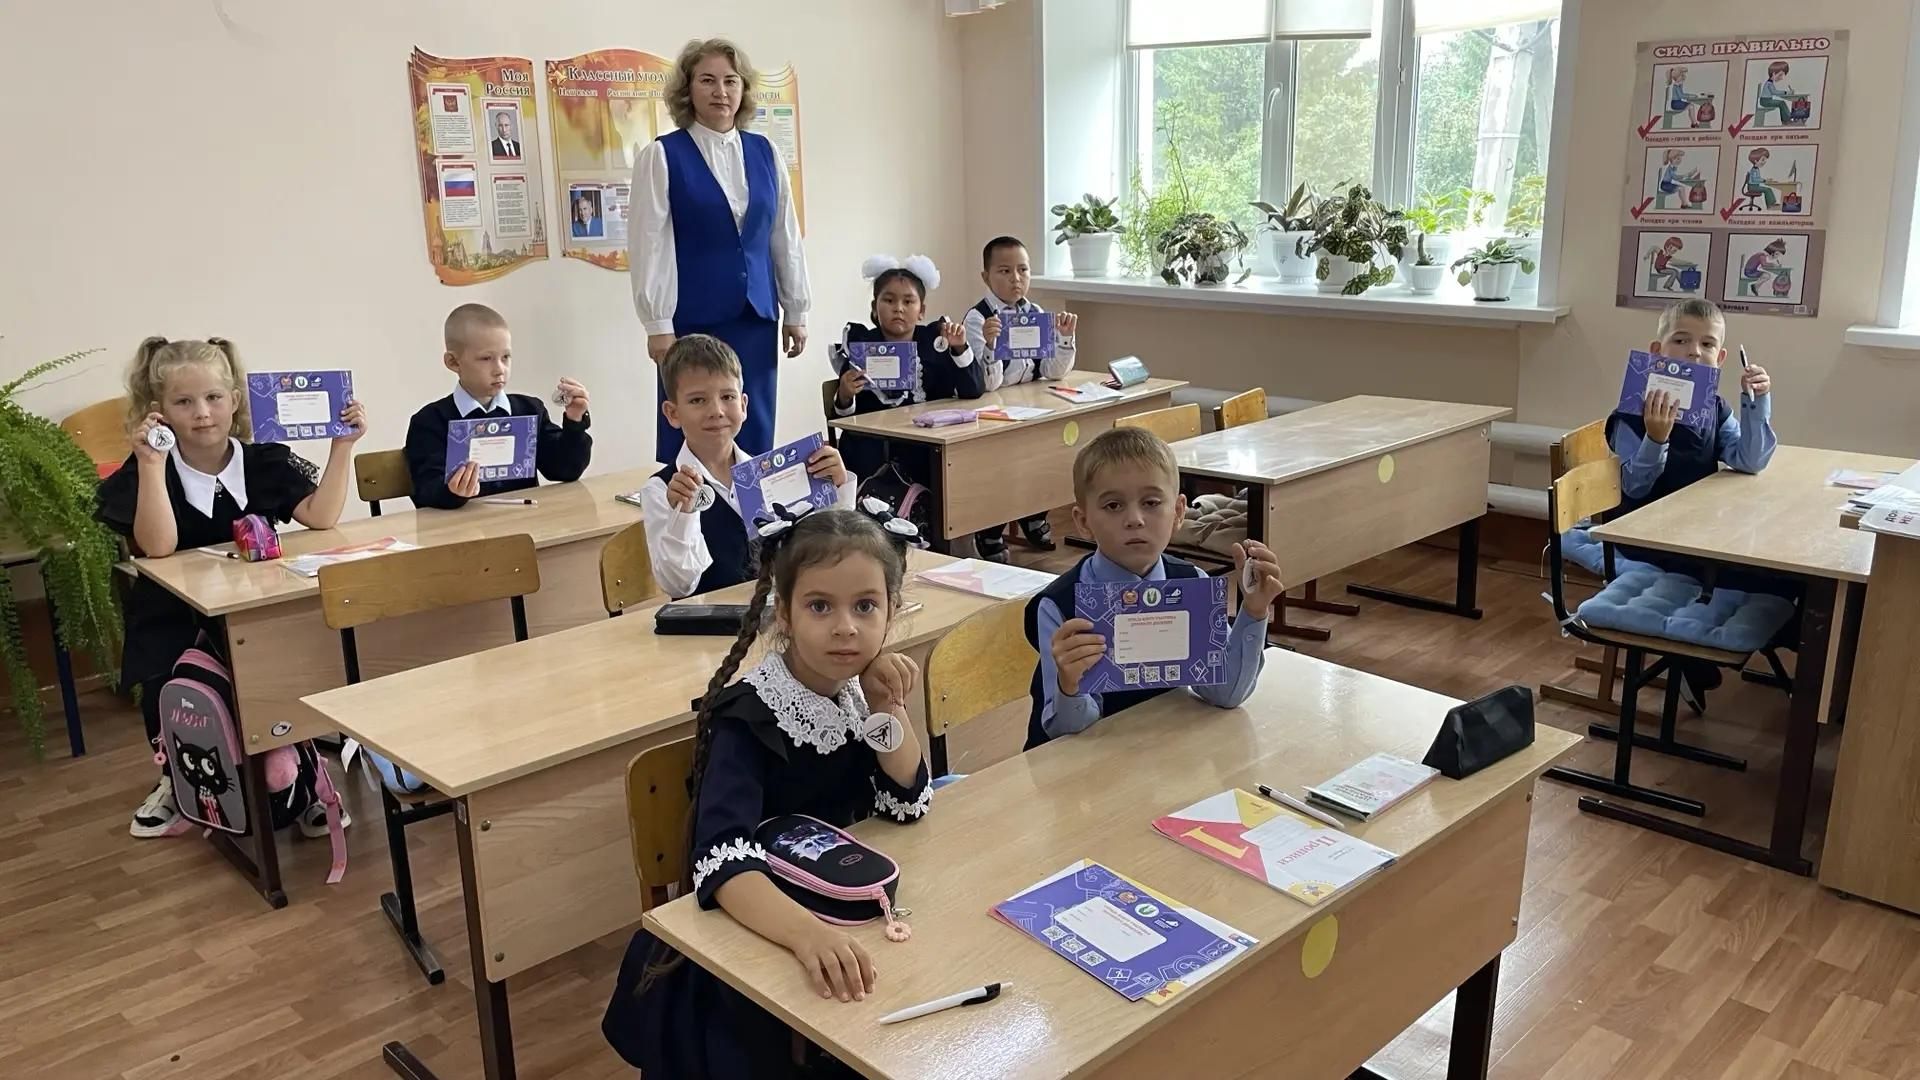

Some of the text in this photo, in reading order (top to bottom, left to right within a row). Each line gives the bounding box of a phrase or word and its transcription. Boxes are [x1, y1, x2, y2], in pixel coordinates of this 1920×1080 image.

[1654, 37, 1830, 58] СИДИ ПРАВИЛЬНО
[501, 68, 529, 81] Моя
[486, 82, 530, 95] Россия
